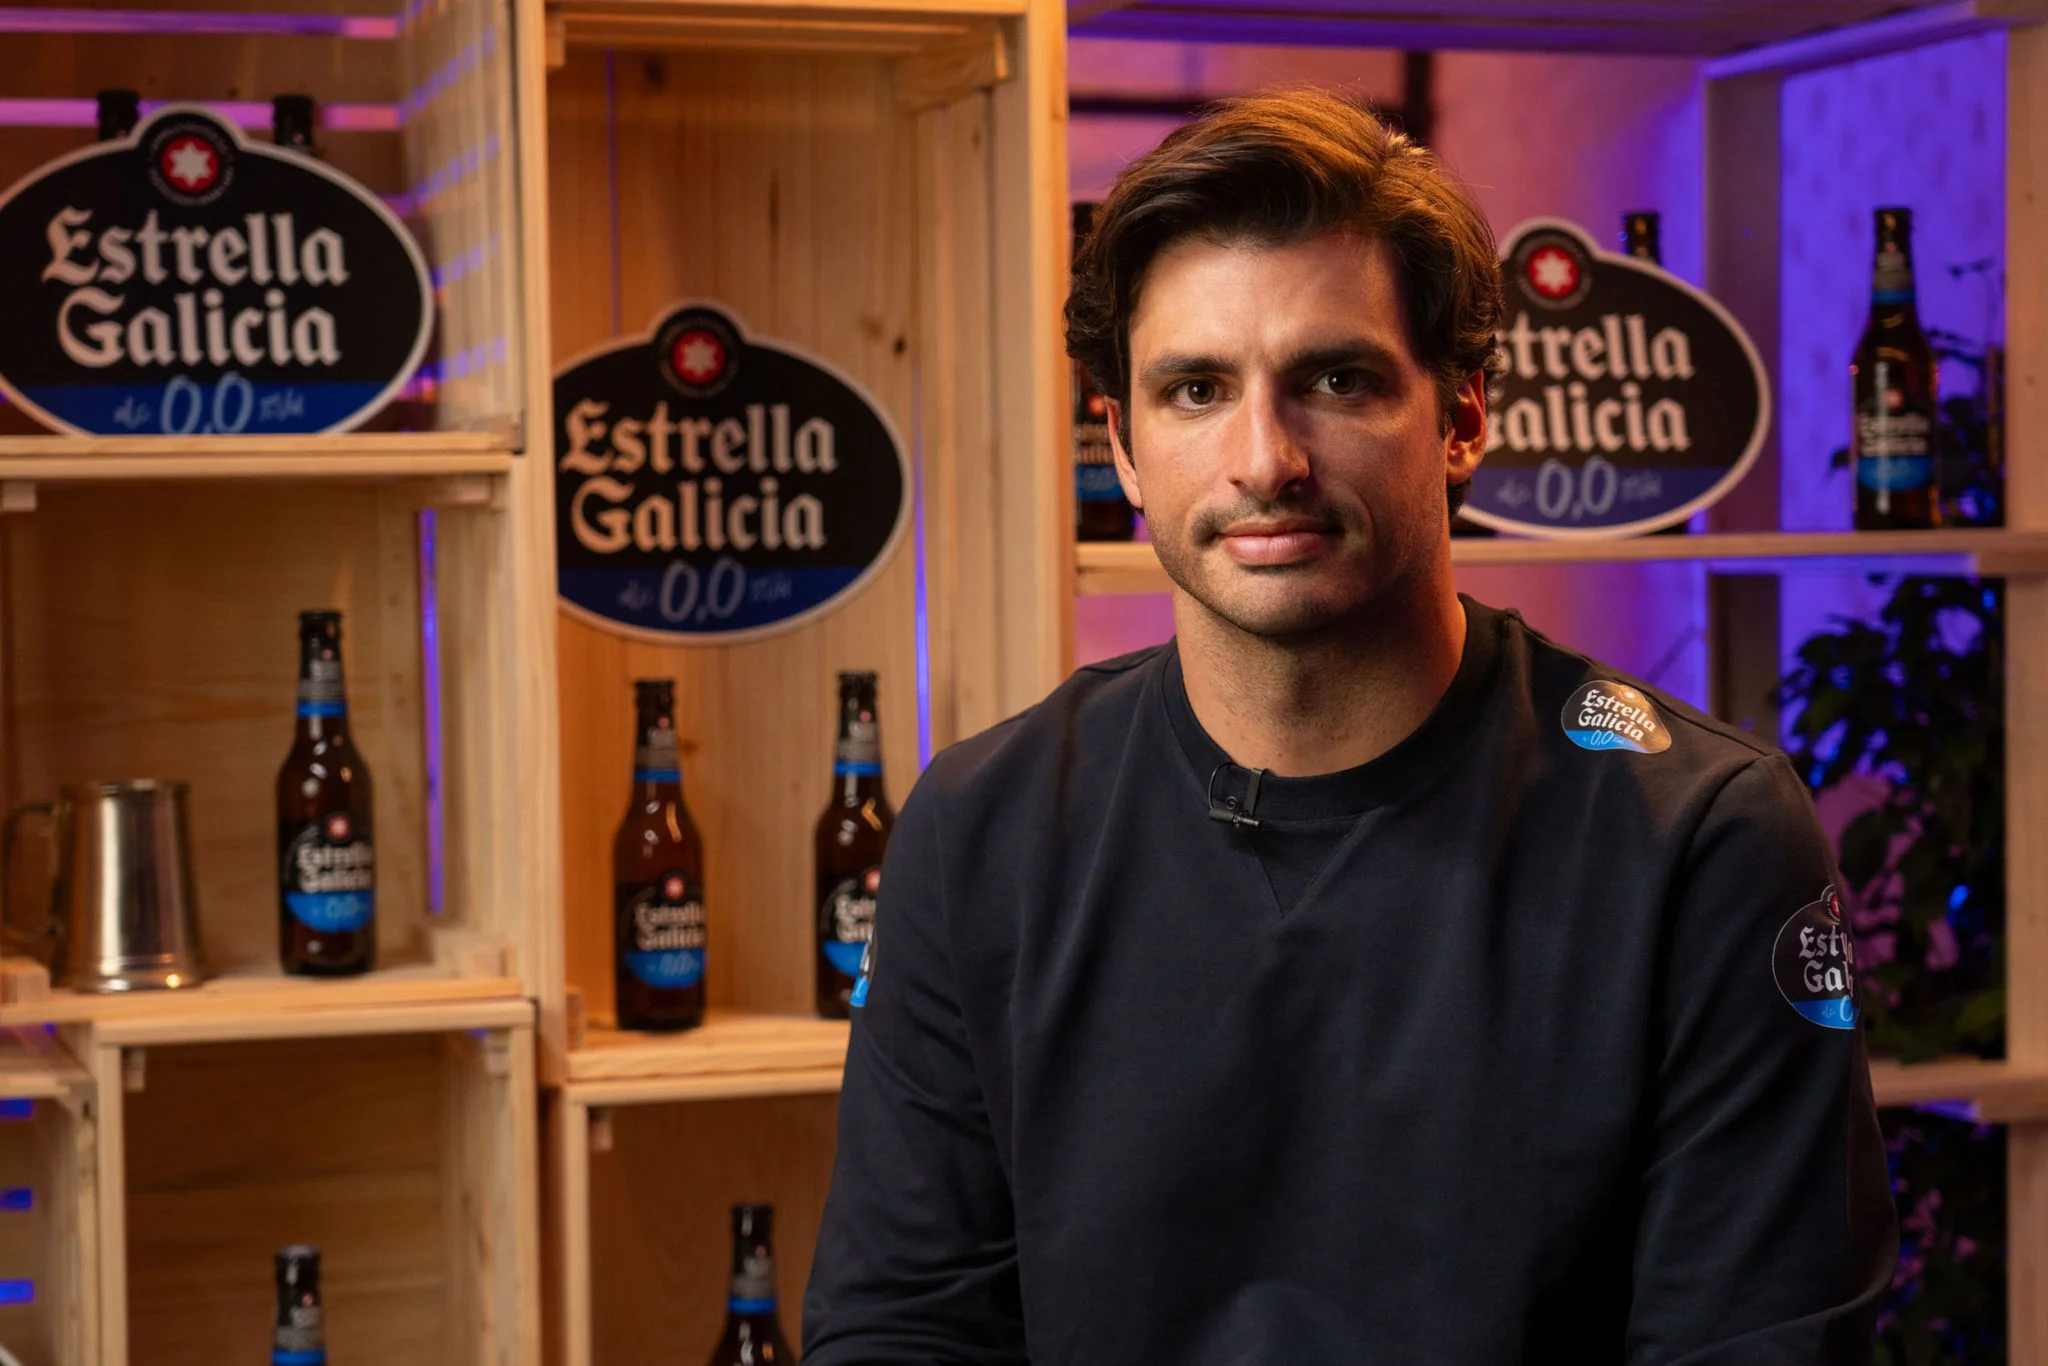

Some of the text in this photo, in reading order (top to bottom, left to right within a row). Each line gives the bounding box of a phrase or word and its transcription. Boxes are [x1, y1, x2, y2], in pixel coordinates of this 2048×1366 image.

[41, 205, 350, 287] Estrella
[57, 286, 341, 368] Galicia
[1491, 310, 1696, 381] strella
[558, 397, 839, 475] Estrella
[1487, 381, 1691, 453] alicia
[570, 476, 827, 554] Galicia
[1535, 454, 1617, 520] 0,0
[658, 556, 747, 624] 0,0
[1578, 707, 1645, 741] Galicia
[1581, 688, 1657, 732] Estrella
